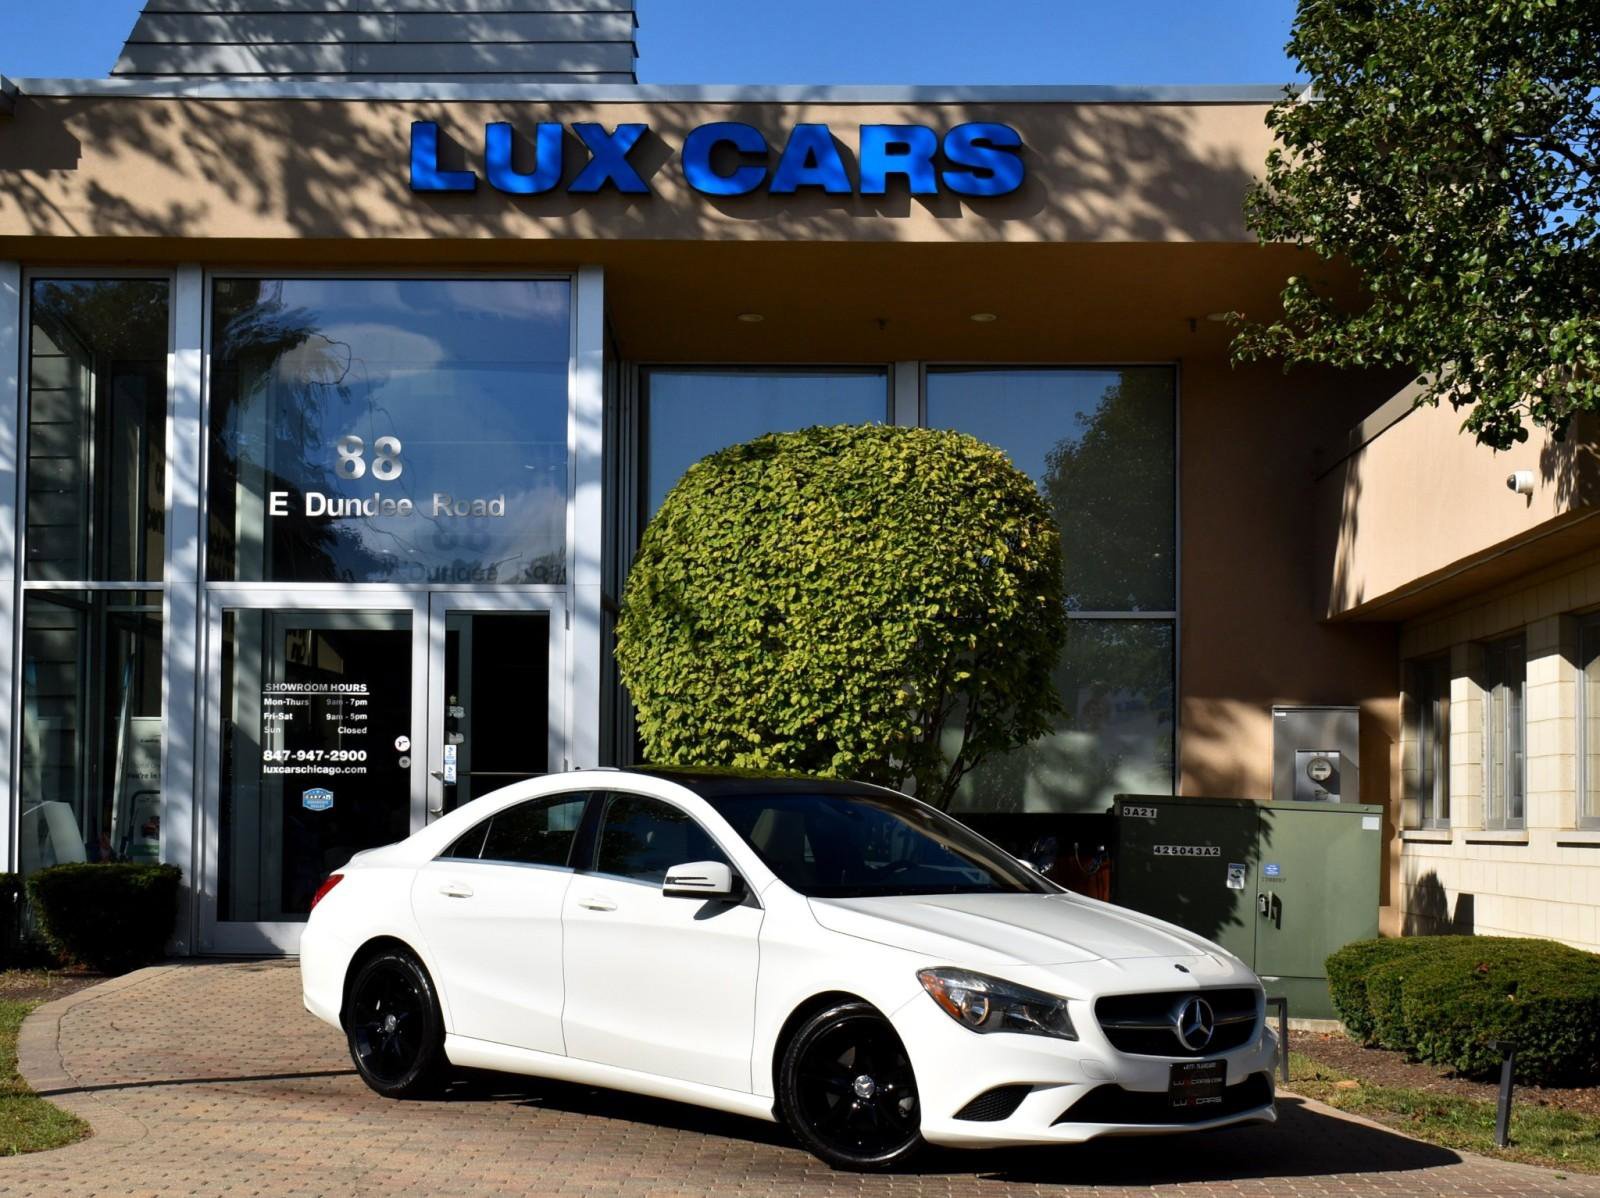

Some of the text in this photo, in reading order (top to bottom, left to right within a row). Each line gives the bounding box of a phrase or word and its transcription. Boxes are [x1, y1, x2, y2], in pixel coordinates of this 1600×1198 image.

[410, 121, 1026, 197] LUX CARS
[335, 435, 403, 481] 88
[269, 491, 505, 517] E Dundee Road
[265, 683, 367, 692] SHOWROOM HOURS
[263, 698, 310, 706] Mon-Thurs
[326, 698, 344, 706] 9am
[350, 698, 368, 707] 7pm
[263, 712, 293, 720] Fri-Sat
[326, 713, 343, 721] 9am
[350, 713, 368, 721] 5pm
[264, 726, 368, 734] Sun Closed
[263, 750, 367, 761] 847-947-2900
[263, 765, 367, 776] luxcarschicago.com
[1124, 807, 1156, 817] 3A21
[1154, 846, 1219, 855] 425043A2
